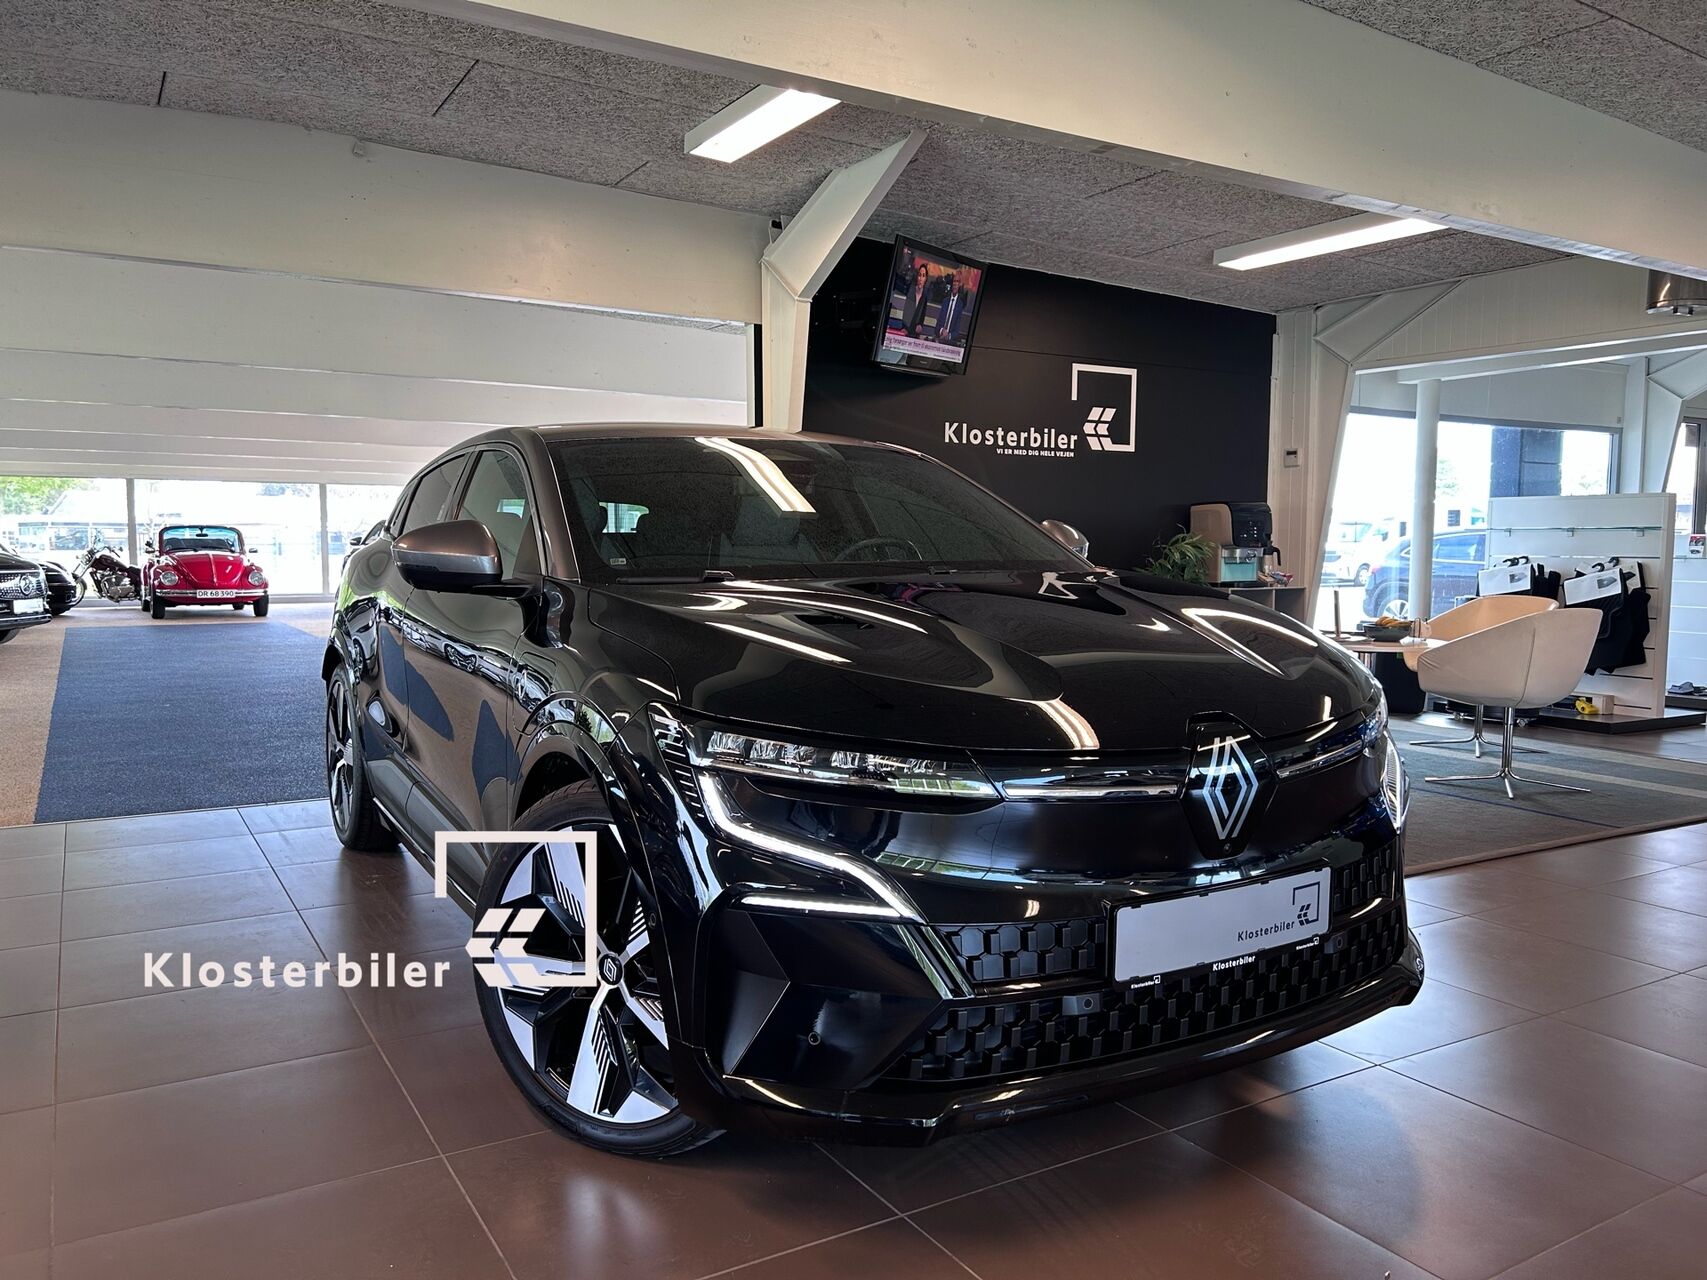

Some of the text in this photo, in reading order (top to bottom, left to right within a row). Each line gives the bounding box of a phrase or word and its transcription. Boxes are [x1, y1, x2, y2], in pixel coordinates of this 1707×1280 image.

[944, 422, 1078, 450] Klosterbiler
[1237, 920, 1295, 942] Klosterbiler
[1212, 955, 1256, 972] Klosterbiler
